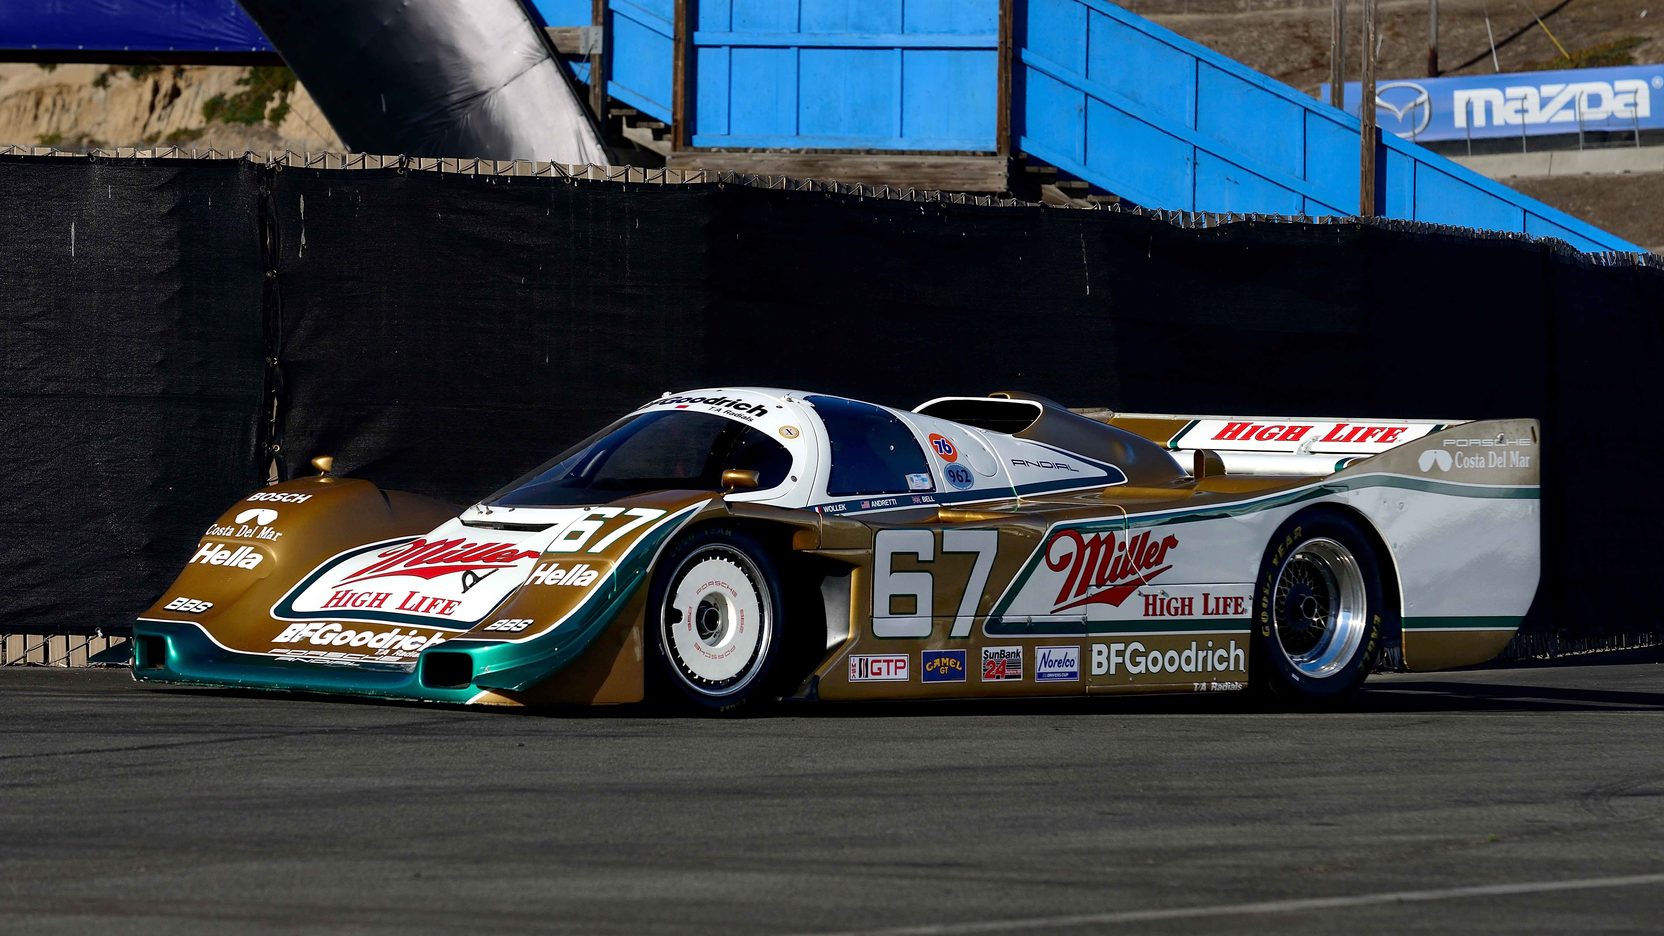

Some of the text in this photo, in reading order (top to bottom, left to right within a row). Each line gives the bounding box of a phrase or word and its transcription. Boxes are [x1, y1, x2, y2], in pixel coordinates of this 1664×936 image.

[1453, 80, 1651, 128] mazda
[724, 409, 754, 422] Radials
[1210, 422, 1409, 444] HIGH LIFE
[933, 438, 954, 455] 76
[1442, 438, 1531, 447] PORSCHE
[1011, 459, 1079, 472] ANDIAL
[1454, 450, 1530, 468] Costa Del Mar
[948, 470, 972, 483] 962
[247, 492, 312, 503] BOSCH
[871, 499, 897, 507] ANDRETTI
[921, 495, 935, 503] BELL
[823, 503, 847, 513] WOLLEK
[205, 523, 282, 542] Costa Del Mar
[546, 507, 667, 553] 67
[188, 542, 264, 570] Hella
[338, 538, 540, 582] Miller
[525, 562, 599, 587] Hella
[1045, 529, 1179, 606] Miller
[696, 580, 738, 598] PORSCHE
[872, 528, 998, 638] 67
[164, 597, 214, 614] BBS
[320, 589, 462, 616] HIGH LIFE
[1143, 592, 1245, 617] HIGH LIFE
[483, 619, 534, 633] BBS
[271, 622, 446, 651] BFGoodrich
[268, 648, 403, 662] PORSCHE
[983, 649, 1021, 660] SunBank
[1038, 650, 1075, 672] Norelco
[1091, 640, 1246, 676] BFGoodrich
[870, 659, 906, 676] GTP
[925, 657, 963, 672] CAMEL
[939, 666, 949, 675] GT
[985, 659, 1007, 680] 24
[1210, 681, 1243, 691] Radials
